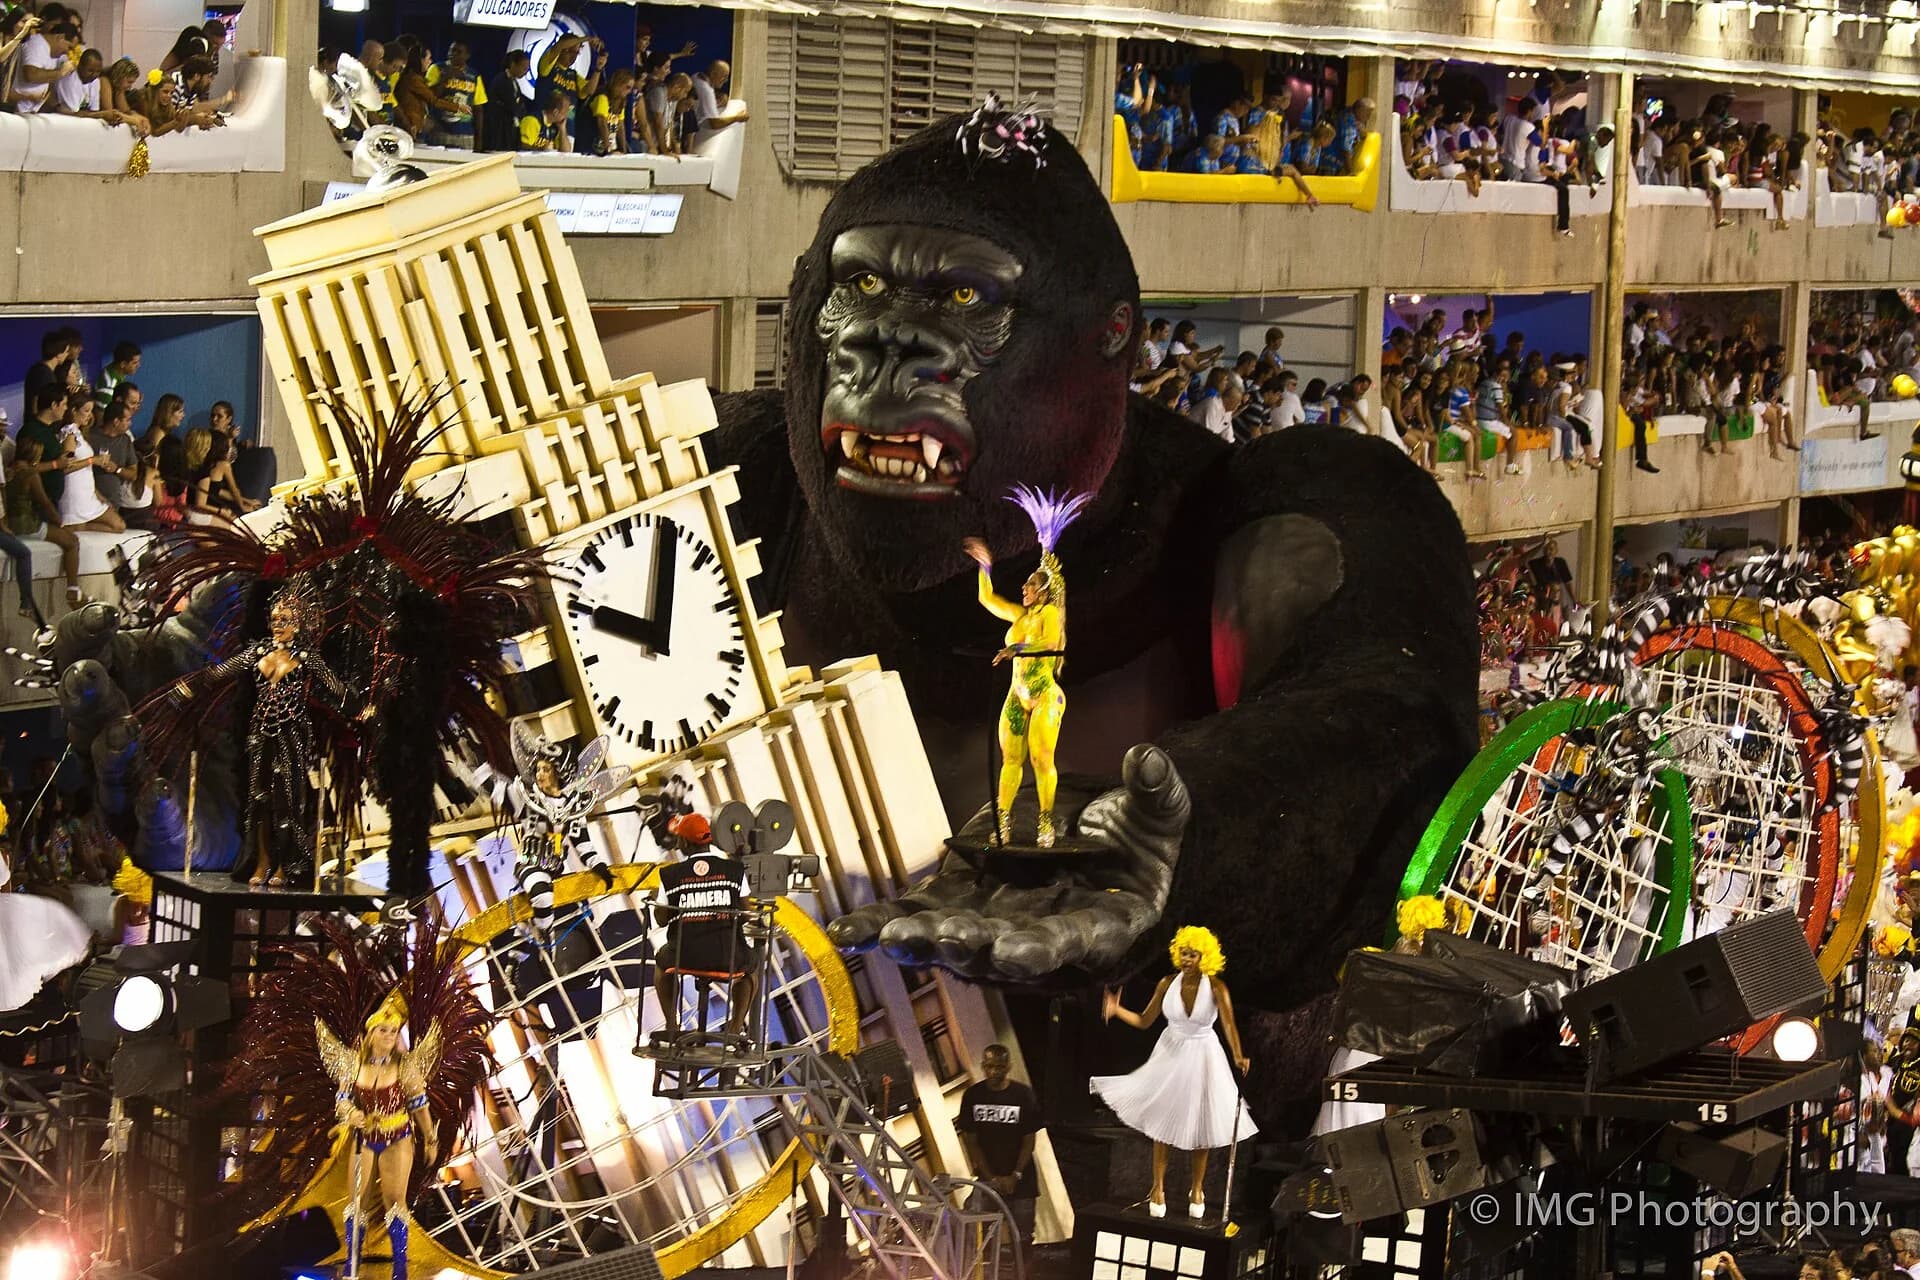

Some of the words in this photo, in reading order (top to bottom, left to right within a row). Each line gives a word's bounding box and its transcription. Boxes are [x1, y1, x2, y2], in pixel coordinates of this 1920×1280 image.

[477, 0, 548, 18] JULGADORES
[679, 889, 731, 909] CAMERA
[1330, 1081, 1359, 1101] 15
[975, 1107, 1019, 1123] GRUA
[1697, 1103, 1728, 1123] 15
